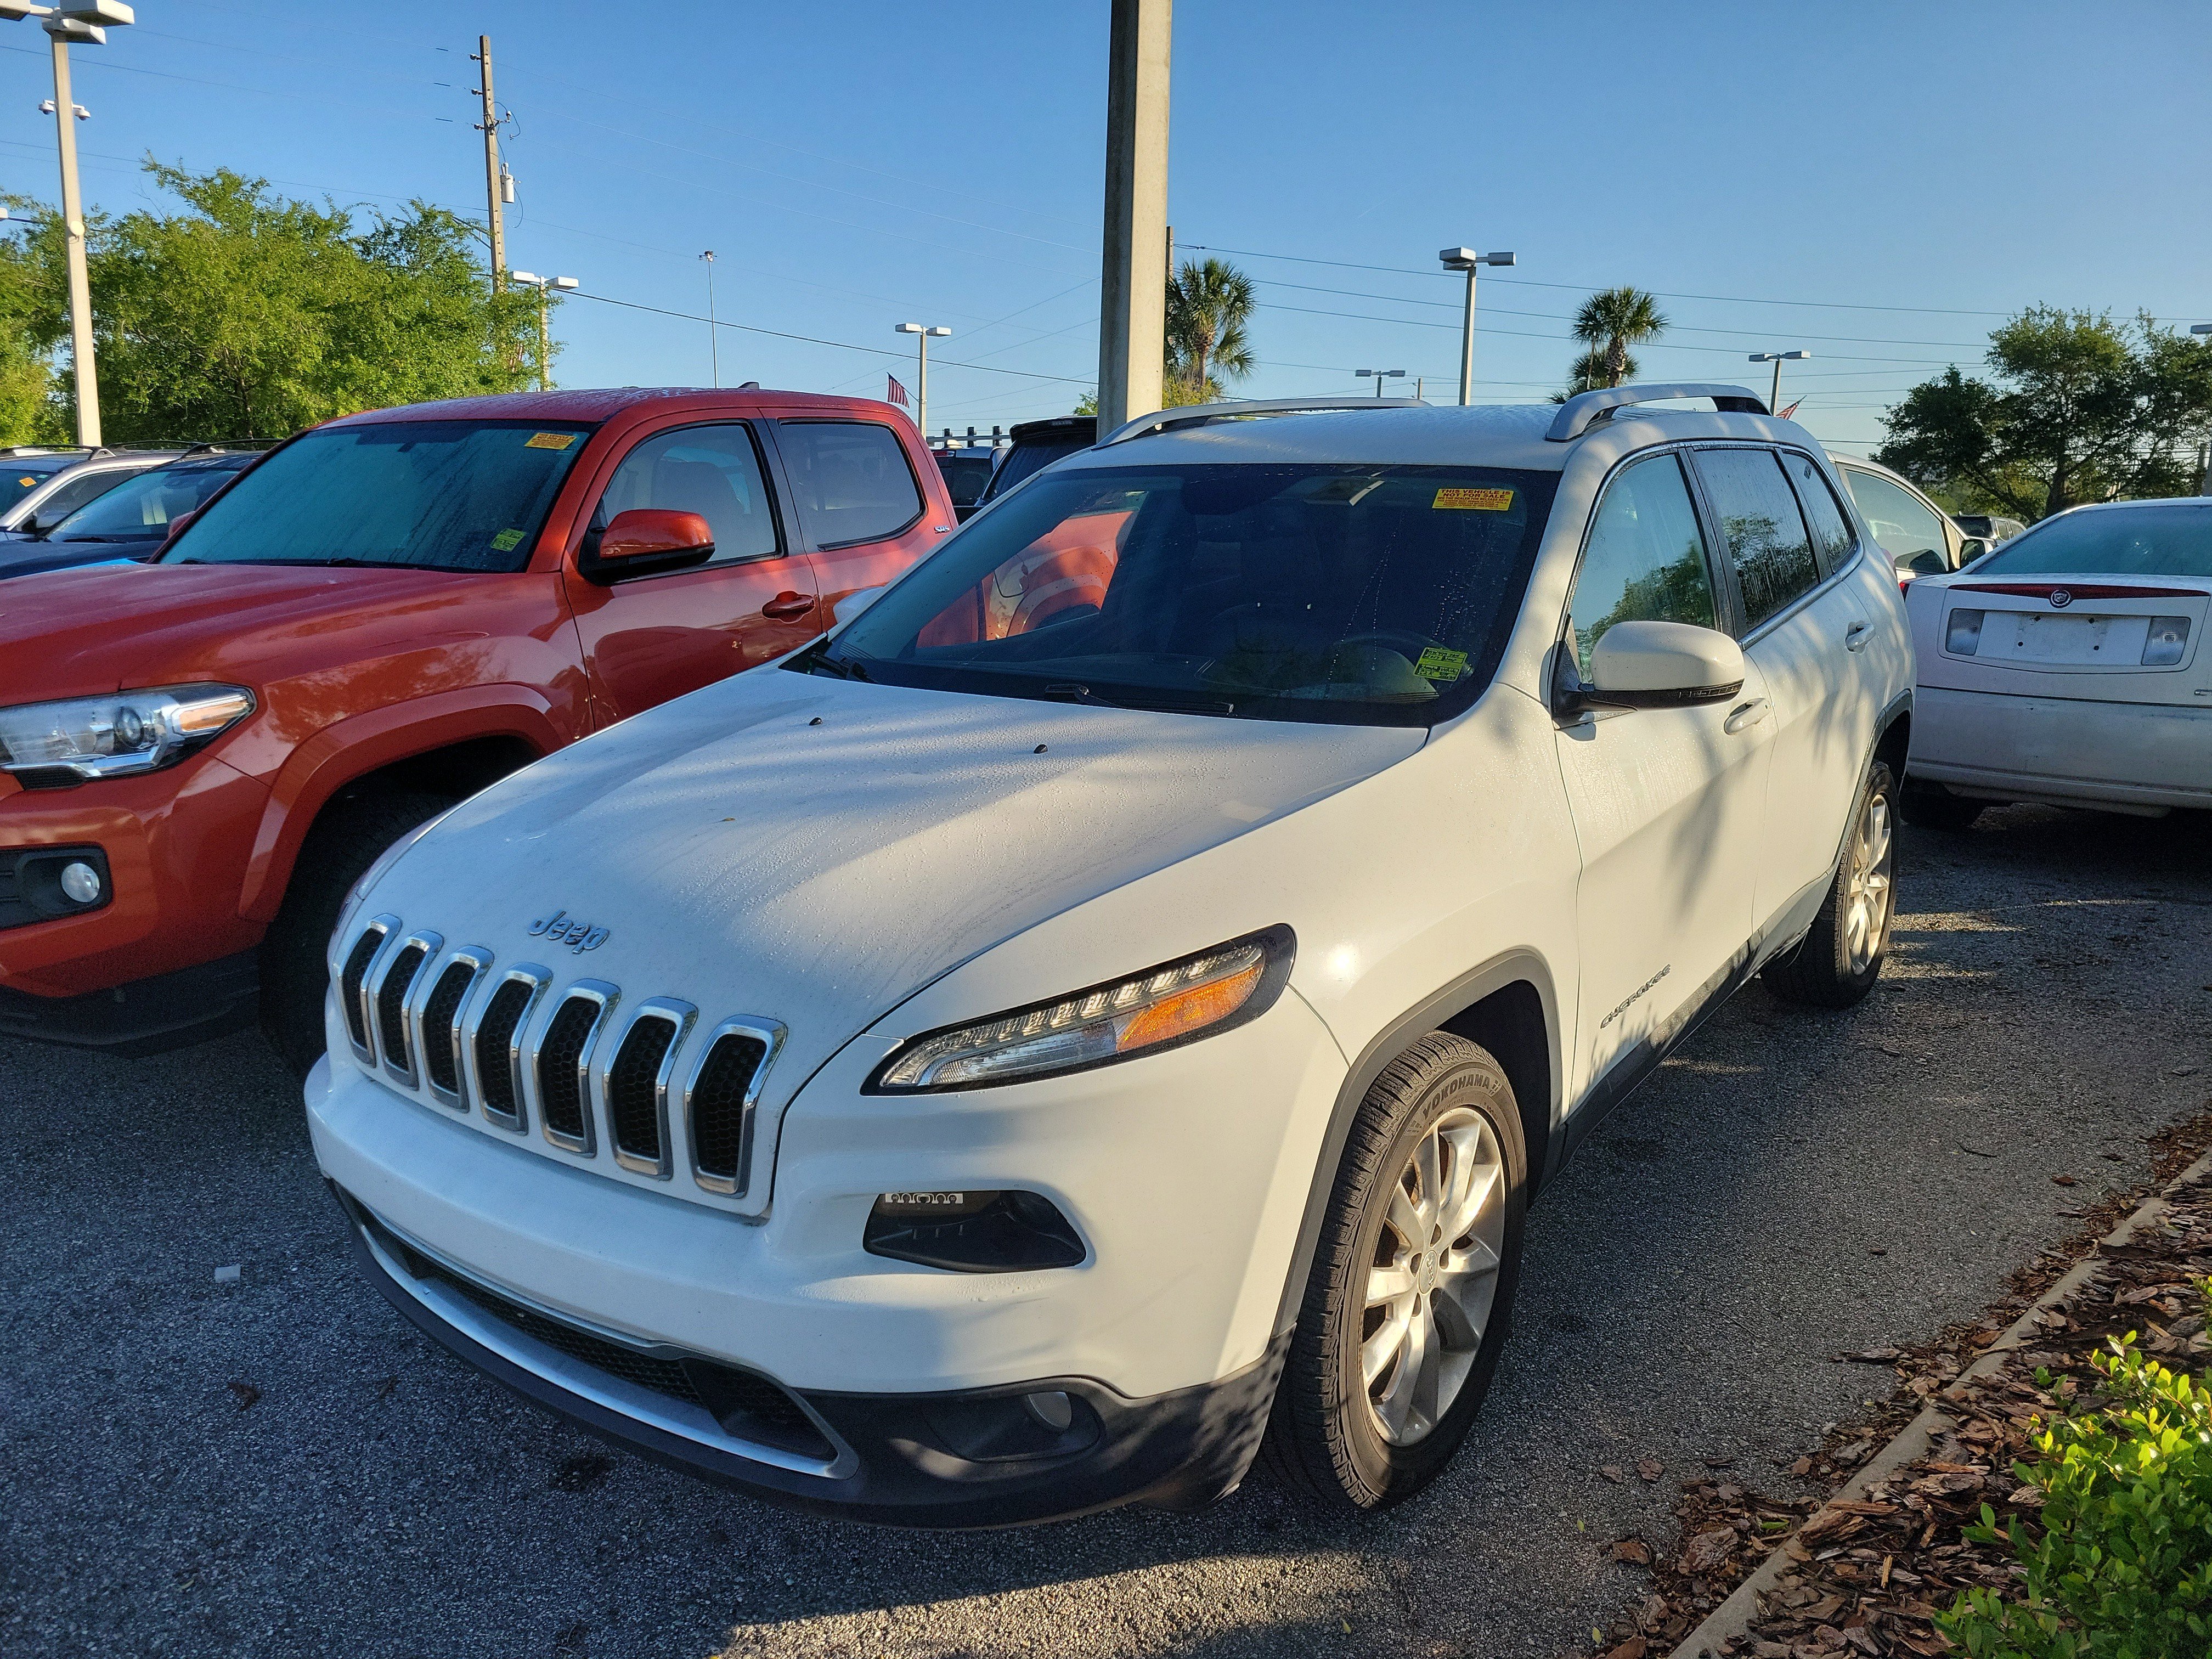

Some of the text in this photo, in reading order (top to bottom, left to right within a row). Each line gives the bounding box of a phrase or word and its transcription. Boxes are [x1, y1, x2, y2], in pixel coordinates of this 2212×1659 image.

[528, 910, 610, 954] Jeep
[1600, 964, 1671, 1029] CHEROKEE
[1423, 1074, 1490, 1120] YOKOHAMA
